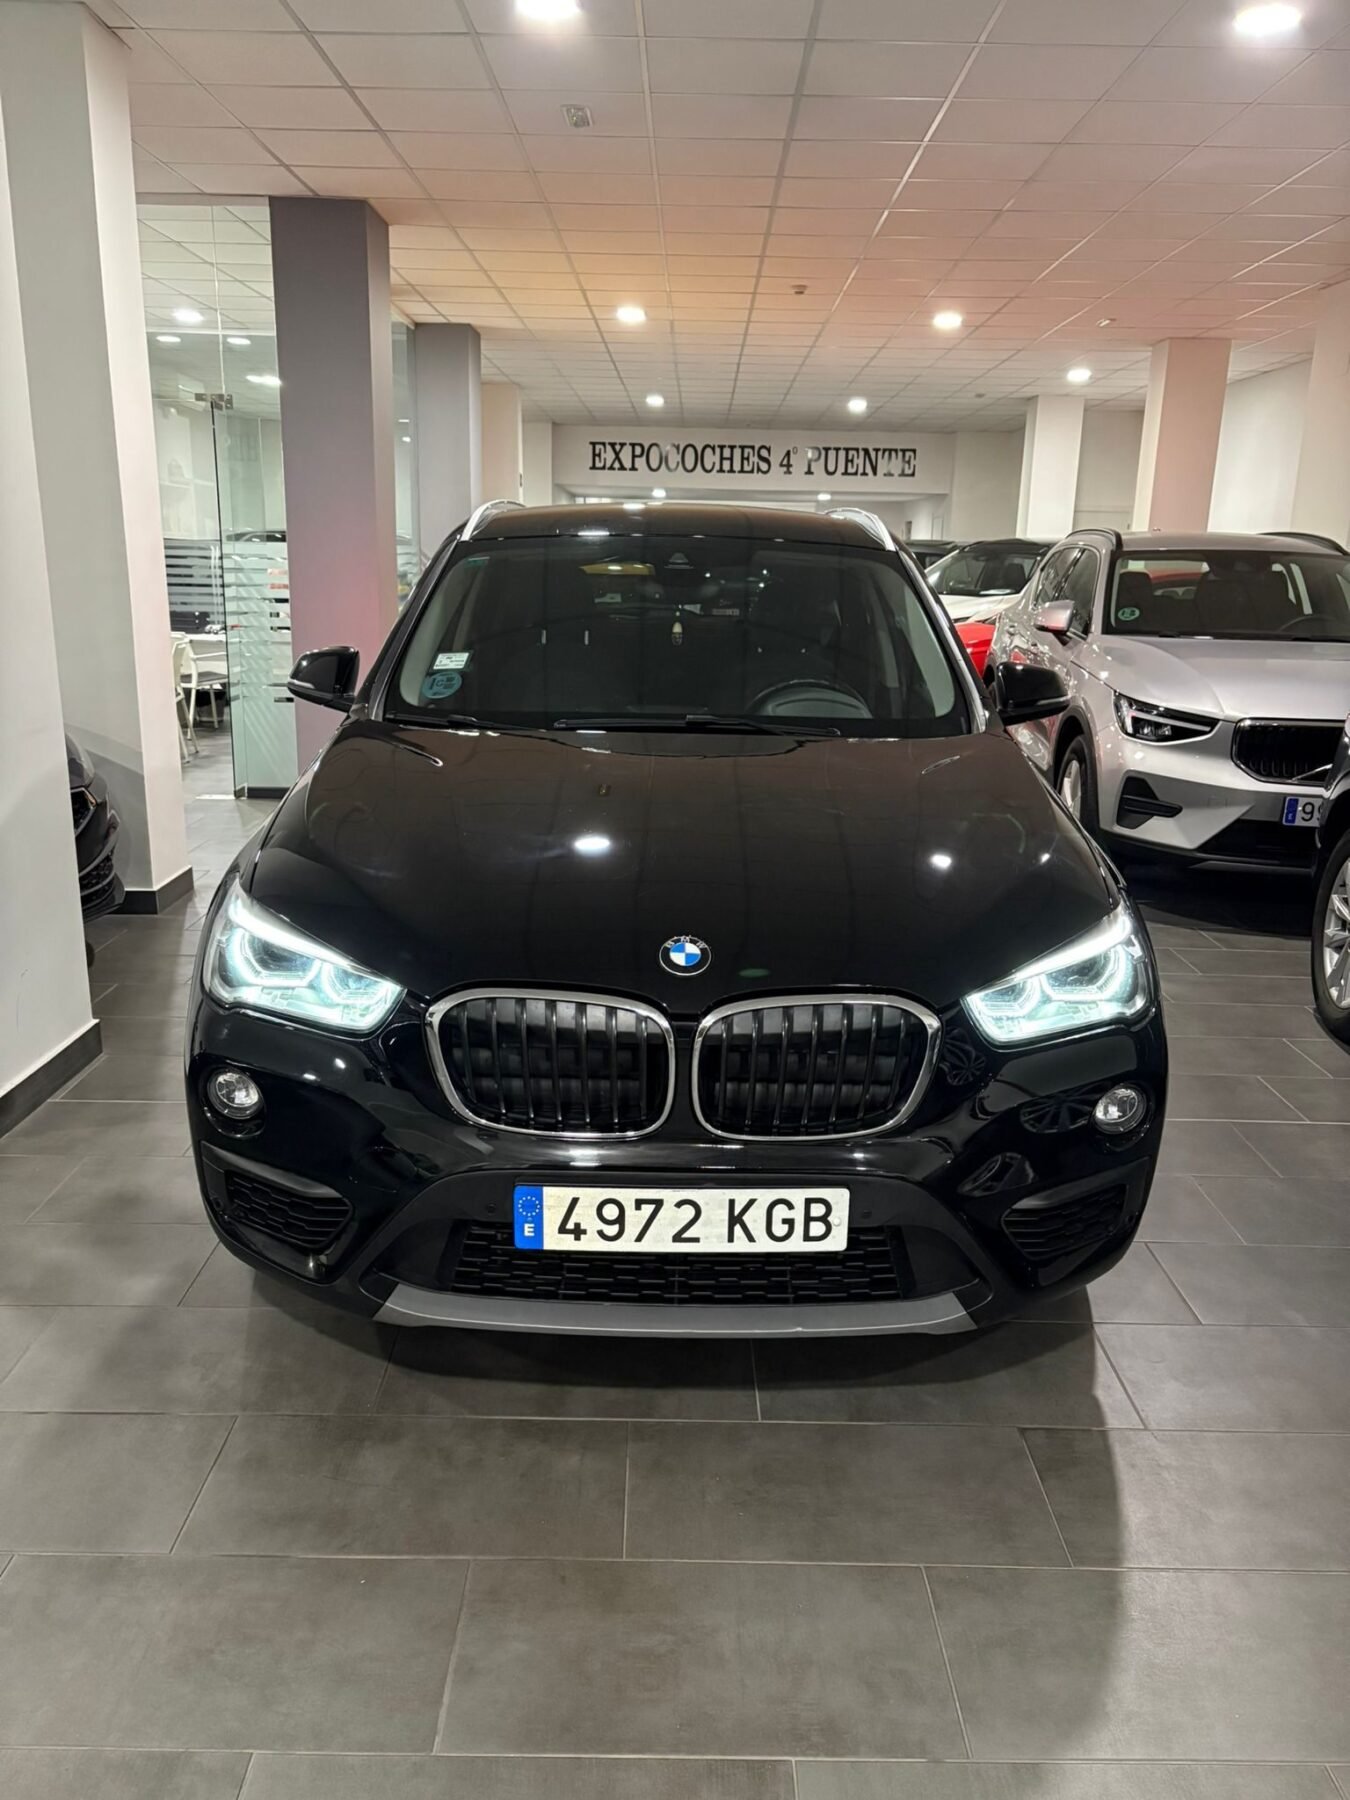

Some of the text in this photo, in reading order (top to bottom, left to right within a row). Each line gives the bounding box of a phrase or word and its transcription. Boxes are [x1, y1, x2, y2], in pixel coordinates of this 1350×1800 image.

[589, 441, 771, 475] EXPOCOCHES
[804, 447, 917, 477] PUENTE
[524, 1197, 833, 1243] E 4972 KGB
